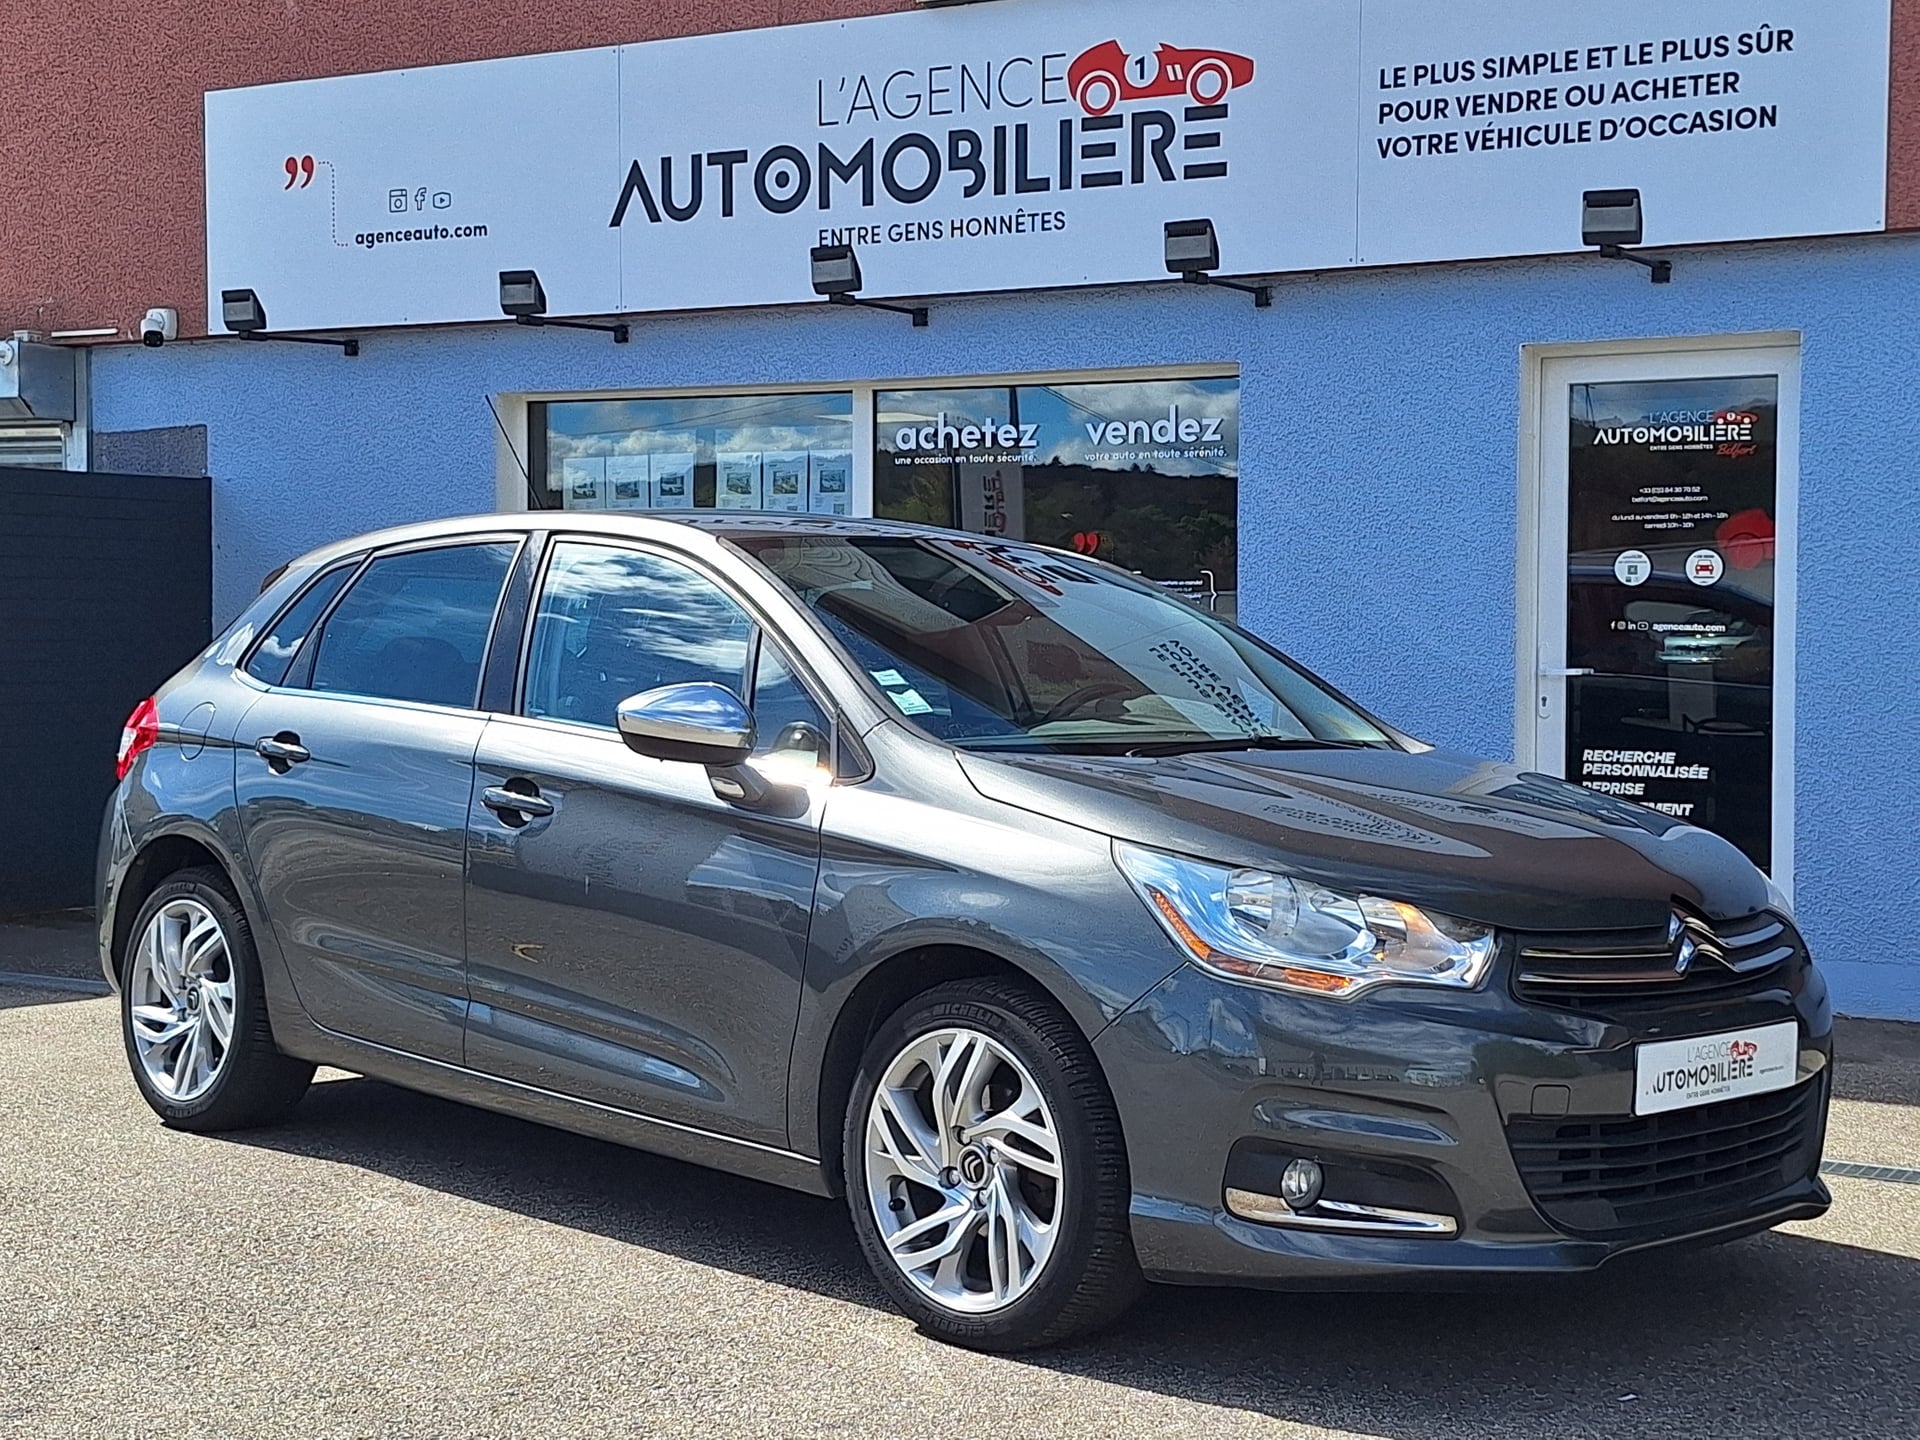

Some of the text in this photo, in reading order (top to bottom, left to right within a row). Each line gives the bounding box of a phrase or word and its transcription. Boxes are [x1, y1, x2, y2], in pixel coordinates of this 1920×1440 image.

[1379, 23, 1795, 90] LE PLUS SIMPLE ET LE PLUS SÛR
[817, 53, 1068, 128] L'AGENCE
[1378, 71, 1740, 124] POUR VENDRE OU ACHETER
[1376, 105, 1778, 159] VOTRE VÉHICULE D'OCCASION
[355, 222, 488, 248] agenceauto.com
[819, 208, 1067, 247] ENTRE GENS HONNÊTES
[895, 411, 1040, 450] achetez
[1085, 404, 1224, 446] vendez
[1650, 410, 1714, 424] L'AGENCE
[895, 457, 912, 465] une
[914, 453, 953, 464] occasion
[969, 454, 995, 463] toute
[1084, 452, 1110, 461] votre
[1112, 450, 1136, 460] auto
[1138, 450, 1151, 459] en
[1153, 449, 1180, 459] toute
[1652, 622, 1726, 632] agenceauto.com
[1582, 749, 1676, 764] RECHERCHE
[1582, 763, 1709, 780] PERSONNALISÉE
